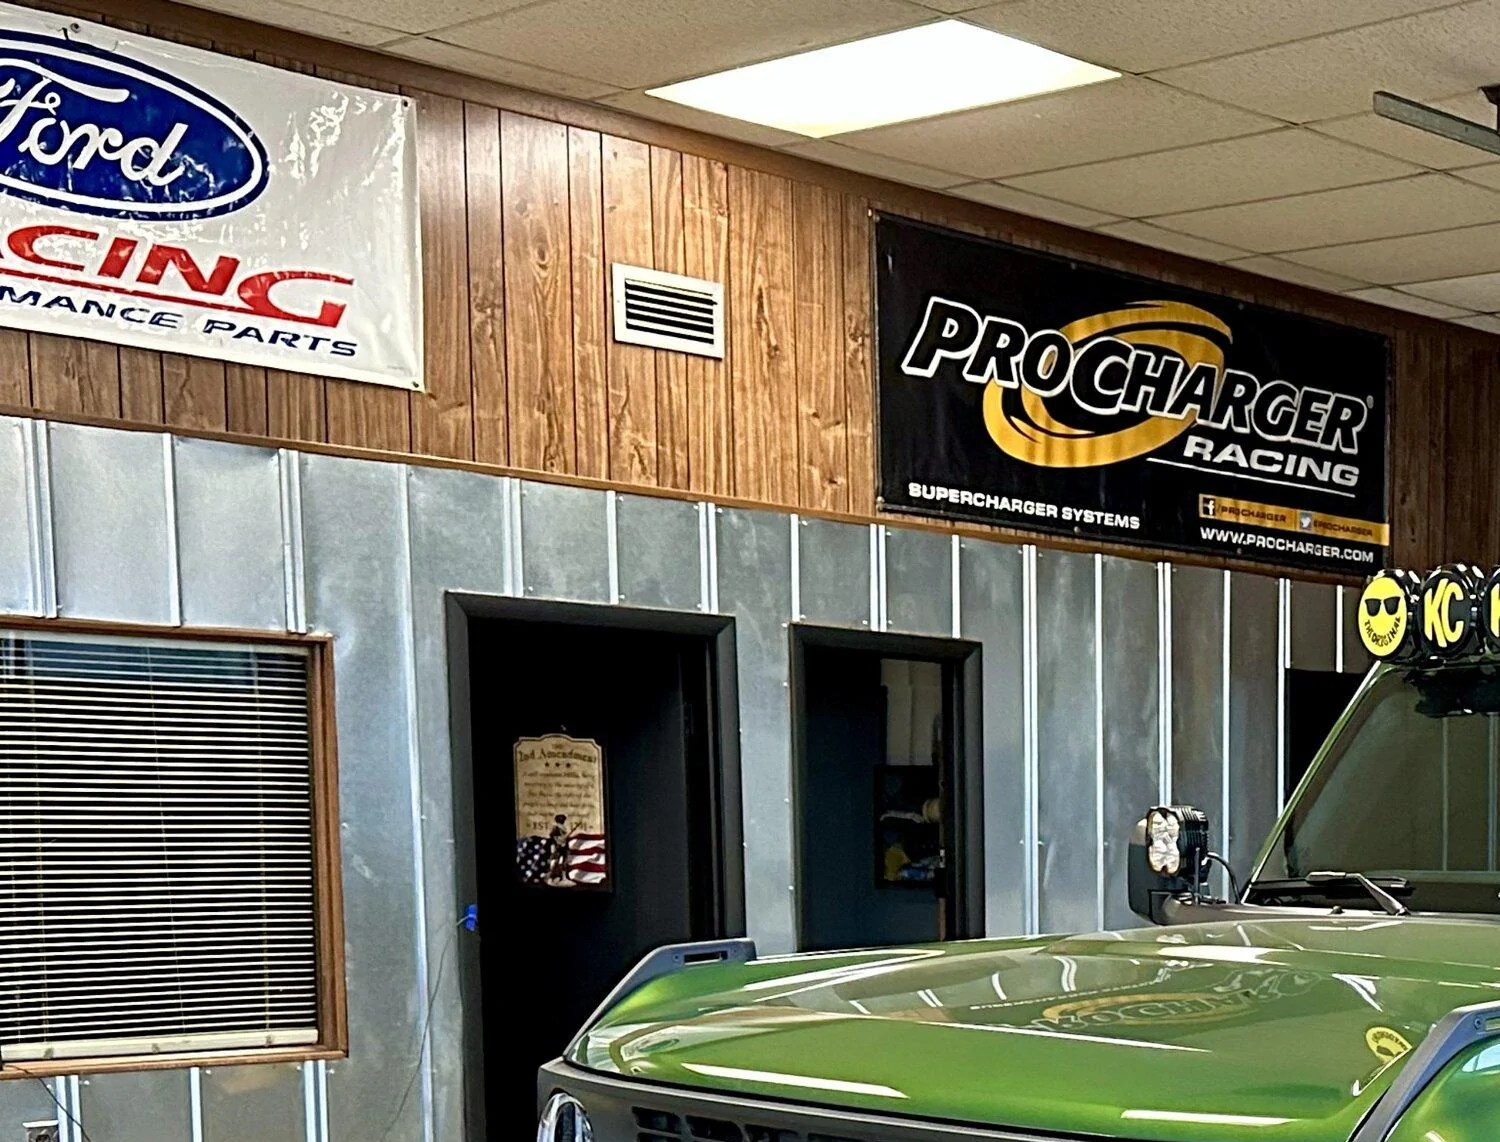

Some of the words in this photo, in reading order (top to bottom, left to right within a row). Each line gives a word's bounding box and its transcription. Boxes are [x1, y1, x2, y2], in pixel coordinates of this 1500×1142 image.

[0, 58, 188, 187] Ford
[0, 225, 354, 328] CING
[203, 318, 358, 358] PARTS
[901, 296, 1368, 454] PROCHARGER
[1183, 435, 1360, 487] RACING
[908, 482, 1058, 518] SUPERCHARGER
[1061, 506, 1141, 530] SYSTEMS
[1200, 526, 1374, 564] WWW.PROCHARGER.COM
[1424, 578, 1464, 648] KC
